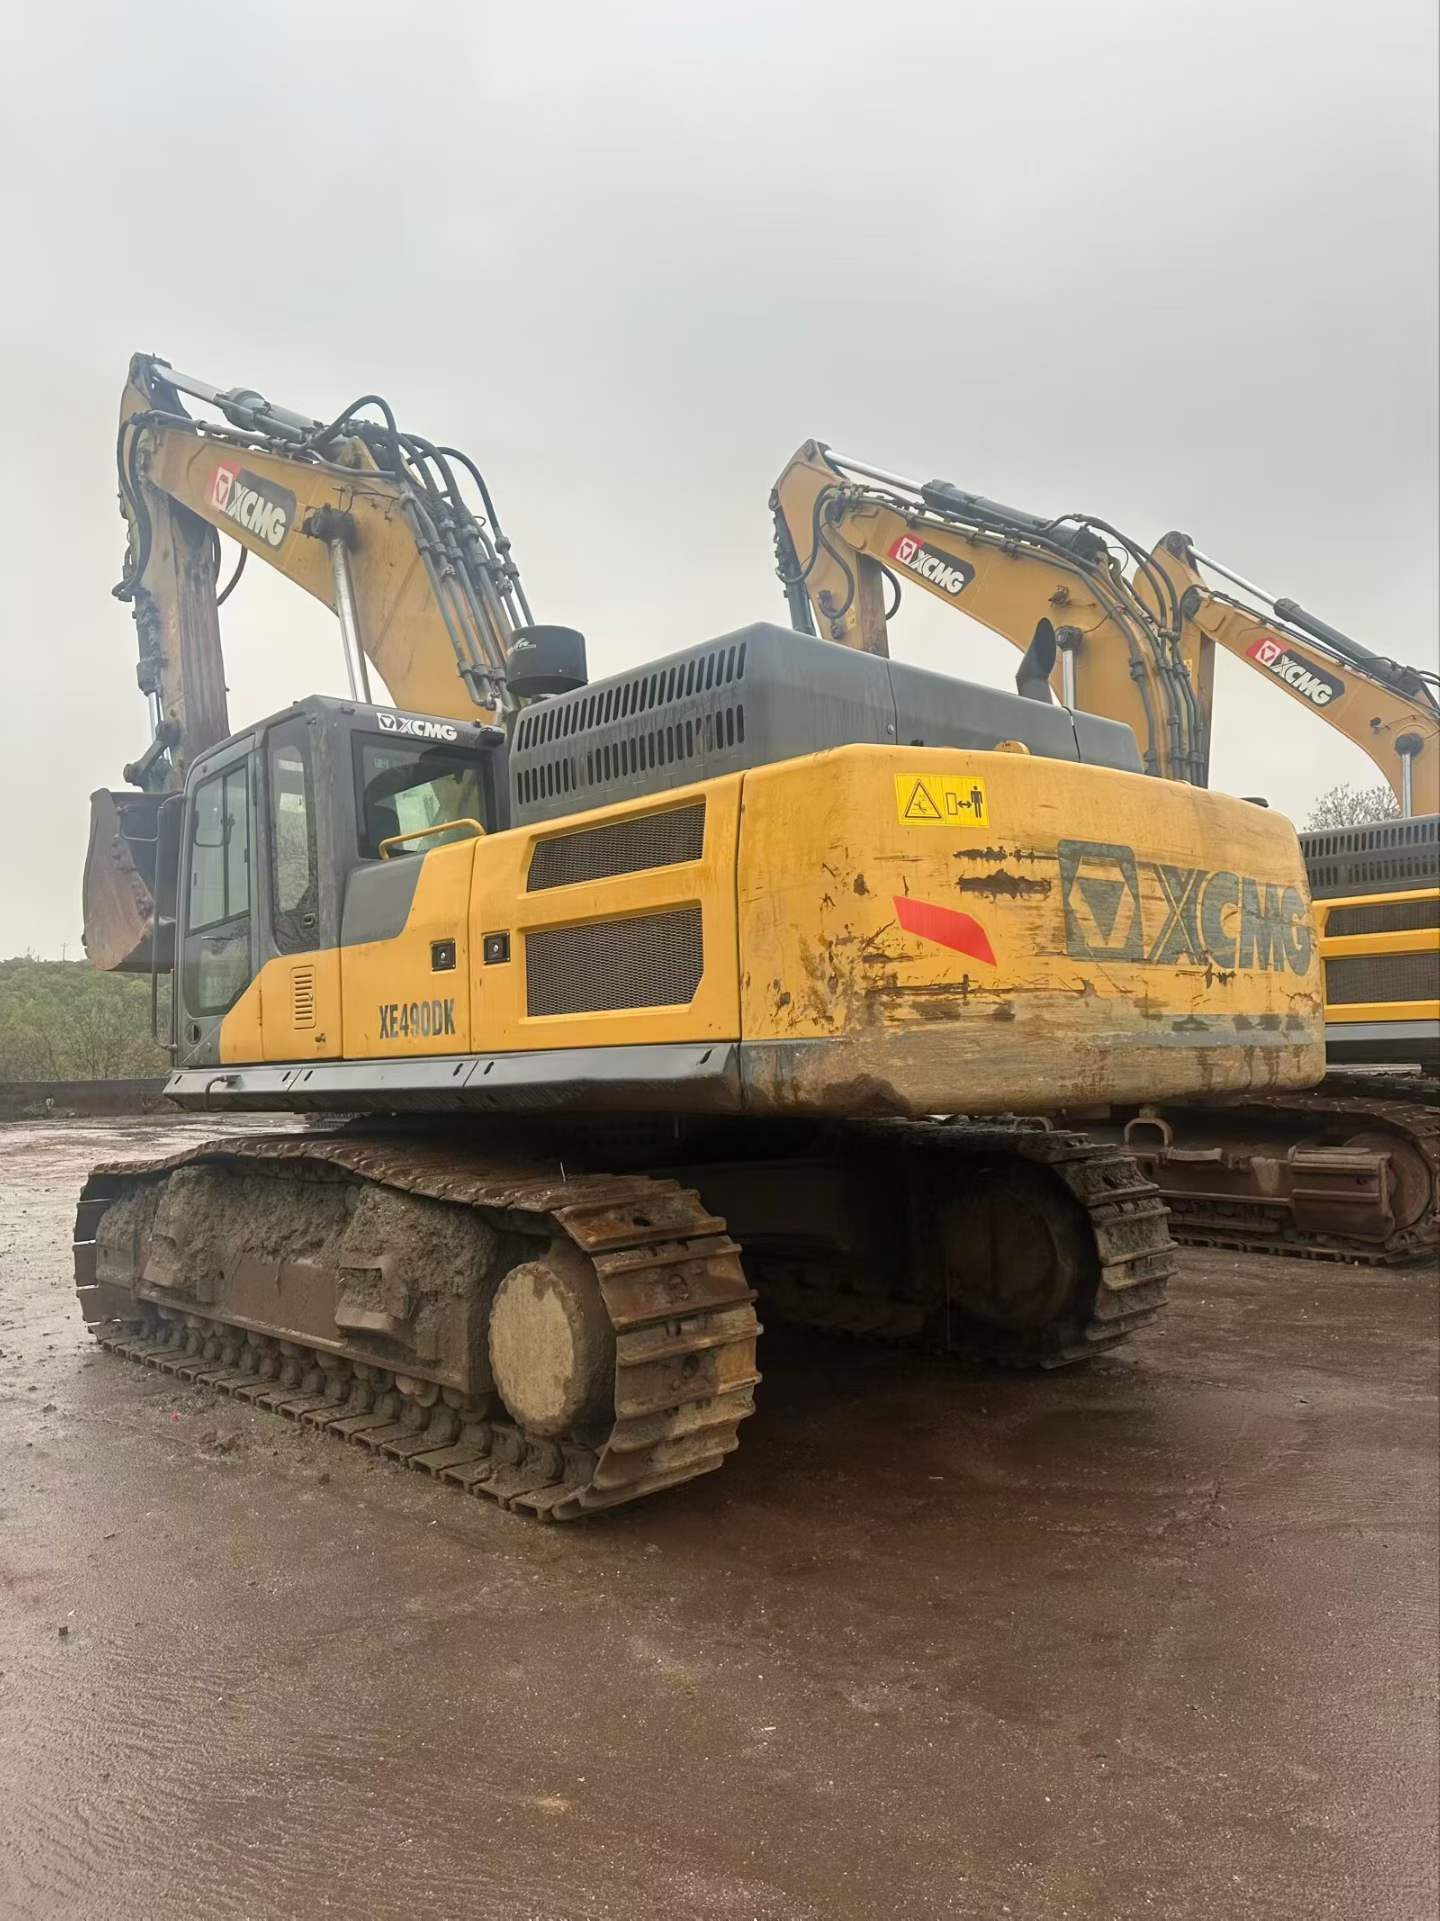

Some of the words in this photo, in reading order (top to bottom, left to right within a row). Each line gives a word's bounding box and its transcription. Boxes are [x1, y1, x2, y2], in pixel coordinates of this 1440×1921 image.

[225, 480, 287, 546] XCMG
[909, 548, 965, 593] XCMG
[1269, 654, 1333, 705] XCMG
[398, 717, 458, 741] XCMG
[1149, 863, 1314, 977] XCMG
[379, 998, 456, 1039] XE490DK
